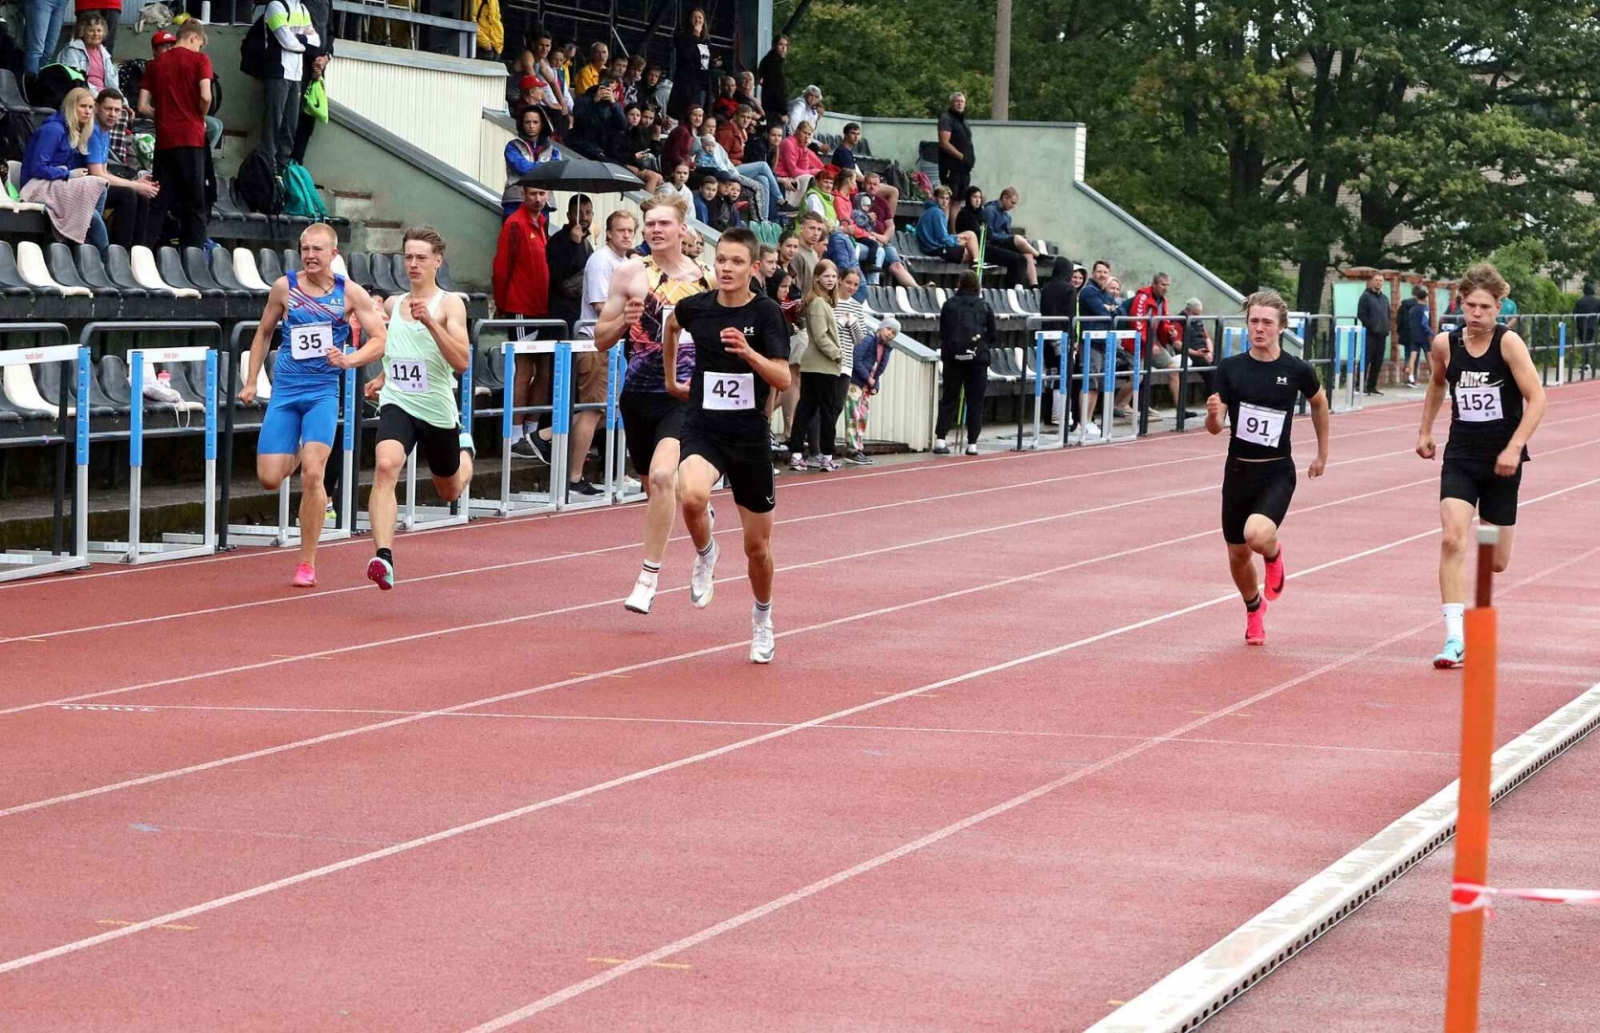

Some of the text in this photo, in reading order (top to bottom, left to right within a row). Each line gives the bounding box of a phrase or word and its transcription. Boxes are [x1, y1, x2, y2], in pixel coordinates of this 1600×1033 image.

[298, 333, 322, 351] 35
[392, 363, 422, 382] 114
[1459, 370, 1490, 387] NIKE
[712, 379, 740, 398] 42
[1461, 393, 1495, 411] 152
[1246, 417, 1270, 437] 91
